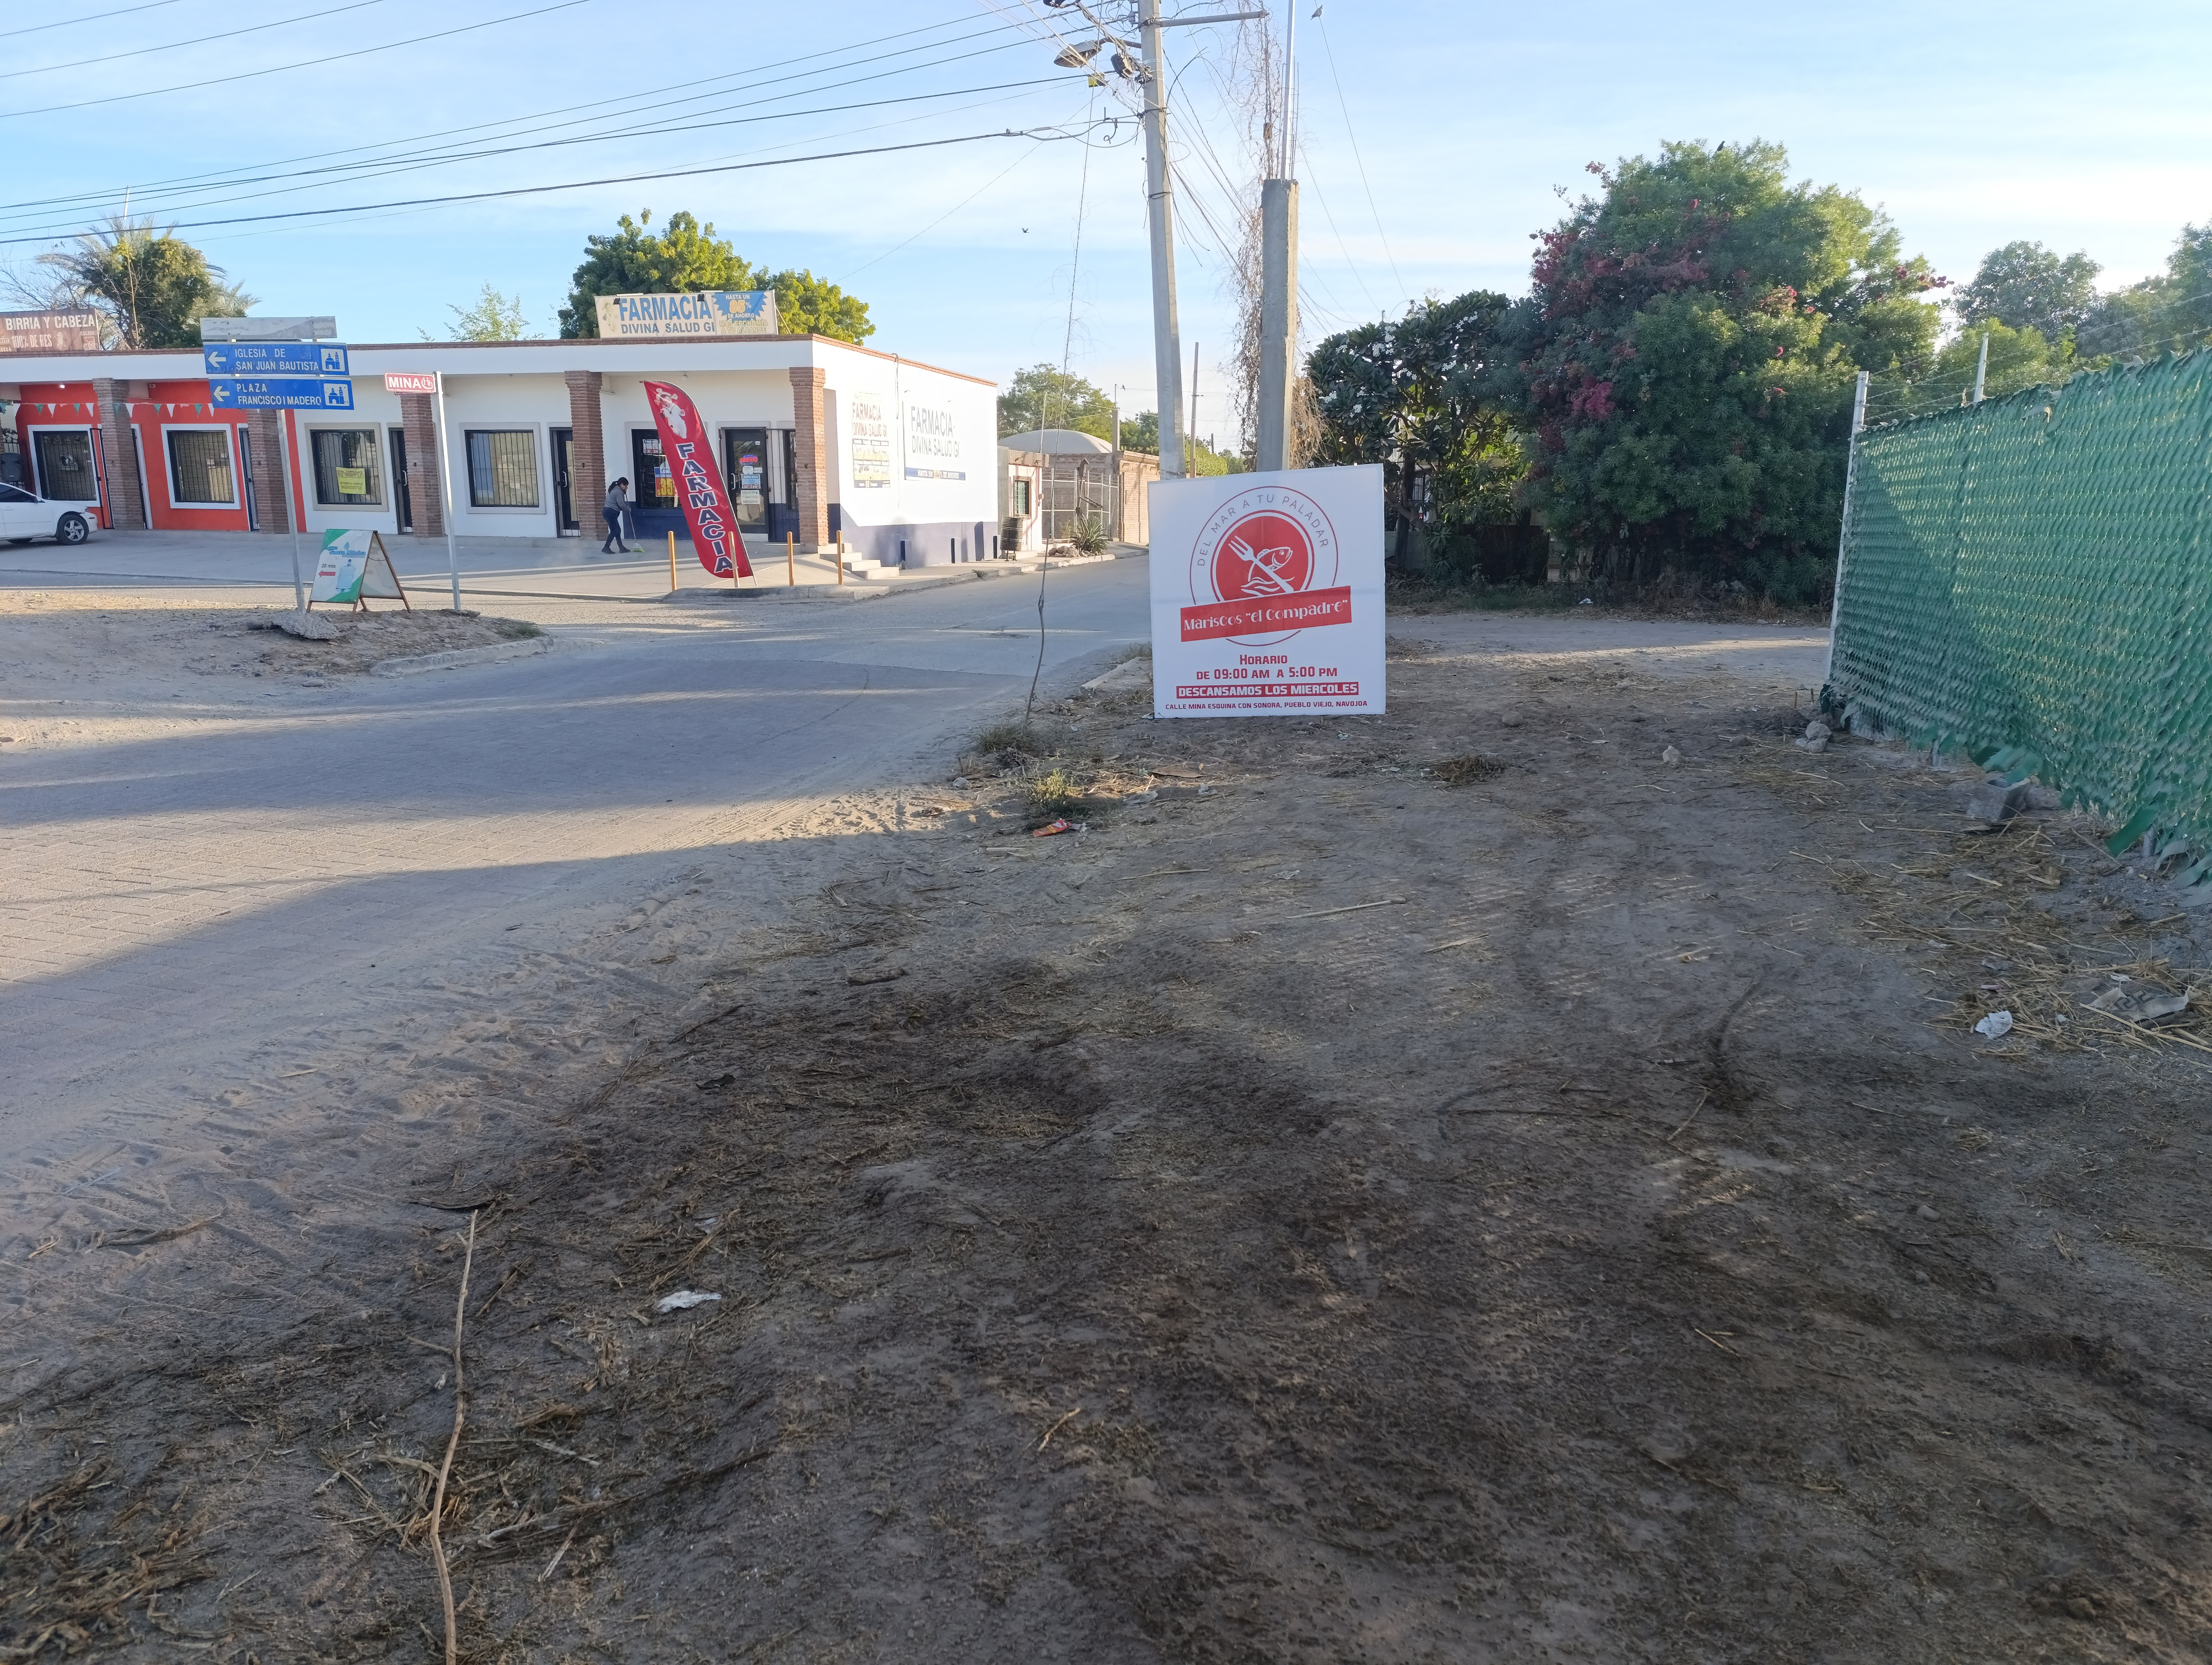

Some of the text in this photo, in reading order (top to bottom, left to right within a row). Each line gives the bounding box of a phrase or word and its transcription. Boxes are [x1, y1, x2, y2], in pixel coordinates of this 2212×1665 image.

[619, 296, 712, 321] FARMACIA
[6, 314, 96, 331] BIRRIA Y CABEZA
[621, 322, 715, 334] DIVINA SALUD GI
[12, 334, 53, 348] 100% DE RES
[235, 349, 286, 358] IGLESIA DE
[236, 361, 319, 370] SAN JUAN BAUTISTA
[236, 383, 267, 392] PLAZA
[388, 376, 422, 389] MINA
[238, 396, 322, 405] FRANCISCO I MADERO
[853, 402, 881, 421] FARMACIA
[911, 406, 953, 438] FARMACIA
[853, 422, 867, 436] DIVINA
[869, 423, 882, 437] SALUD
[912, 435, 932, 455] DIVINA
[933, 438, 952, 457] SALUD
[676, 442, 738, 573] FARMACIA
[1197, 494, 1328, 566] DEL MAR A TU PALADAR
[1183, 615, 1242, 631] Mariscos
[1240, 654, 1288, 665] HORARIO
[1196, 666, 1337, 680] DE 09:00 AM A 5:00 PM
[1178, 684, 1357, 697] DESCANSAMOS LOS MIERCOLES
